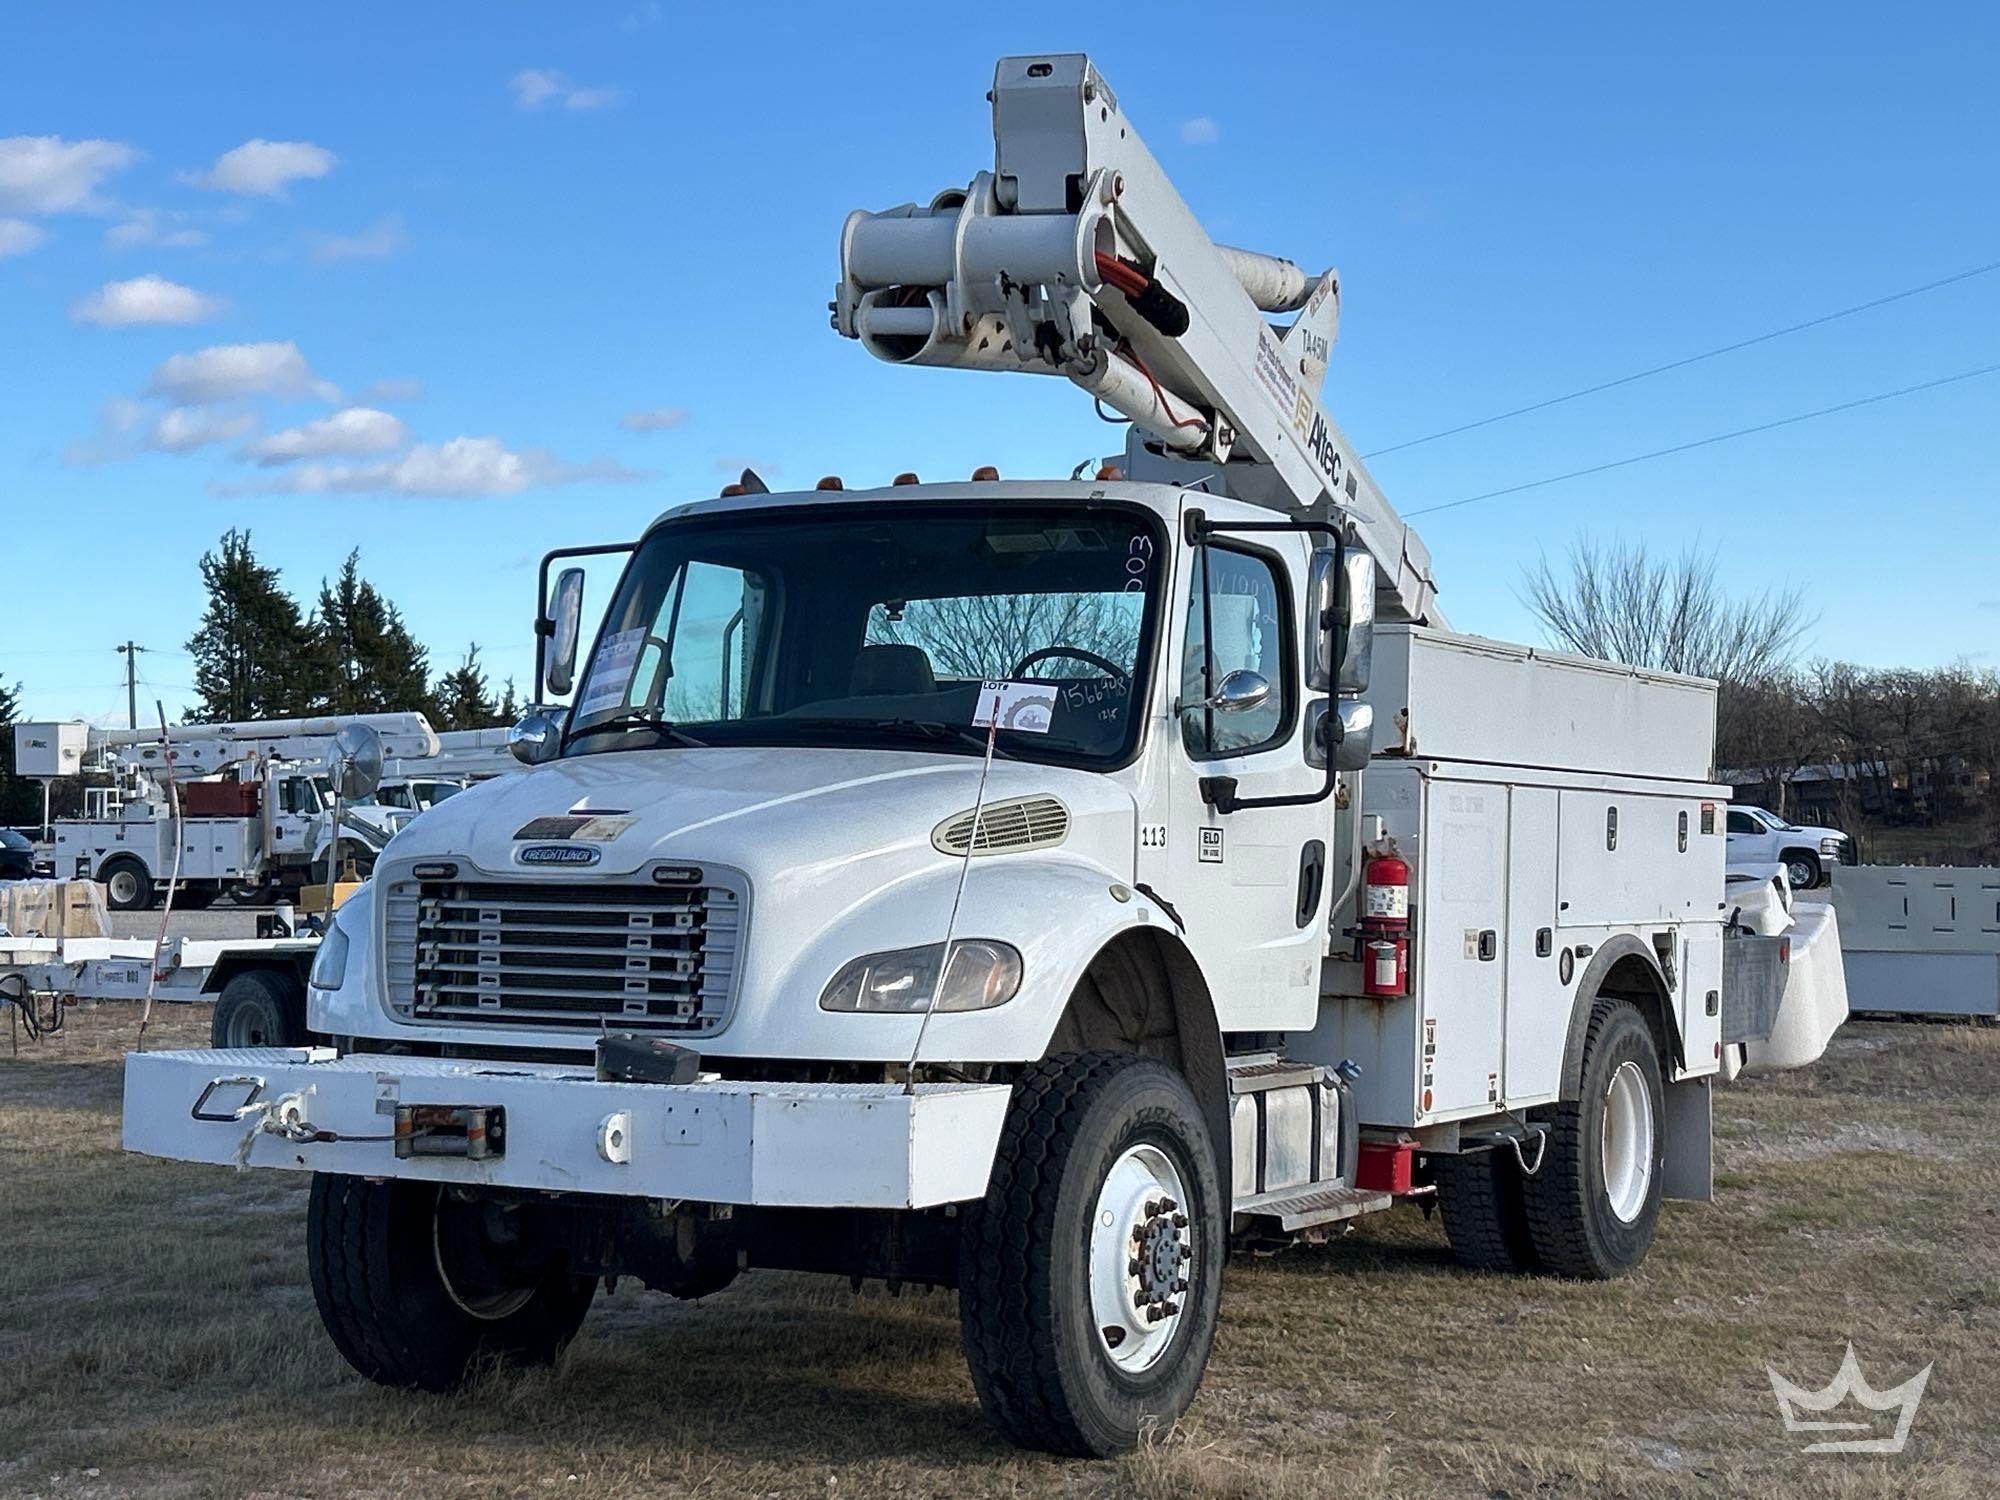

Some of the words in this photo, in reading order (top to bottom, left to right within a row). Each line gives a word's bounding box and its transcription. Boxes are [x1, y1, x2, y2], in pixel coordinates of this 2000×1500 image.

[1307, 411, 1342, 487] Altec
[983, 681, 1009, 691] LOT#
[1142, 826, 1166, 847] 113
[1203, 831, 1220, 845] ELD
[524, 847, 591, 862] FREIGHTLINER
